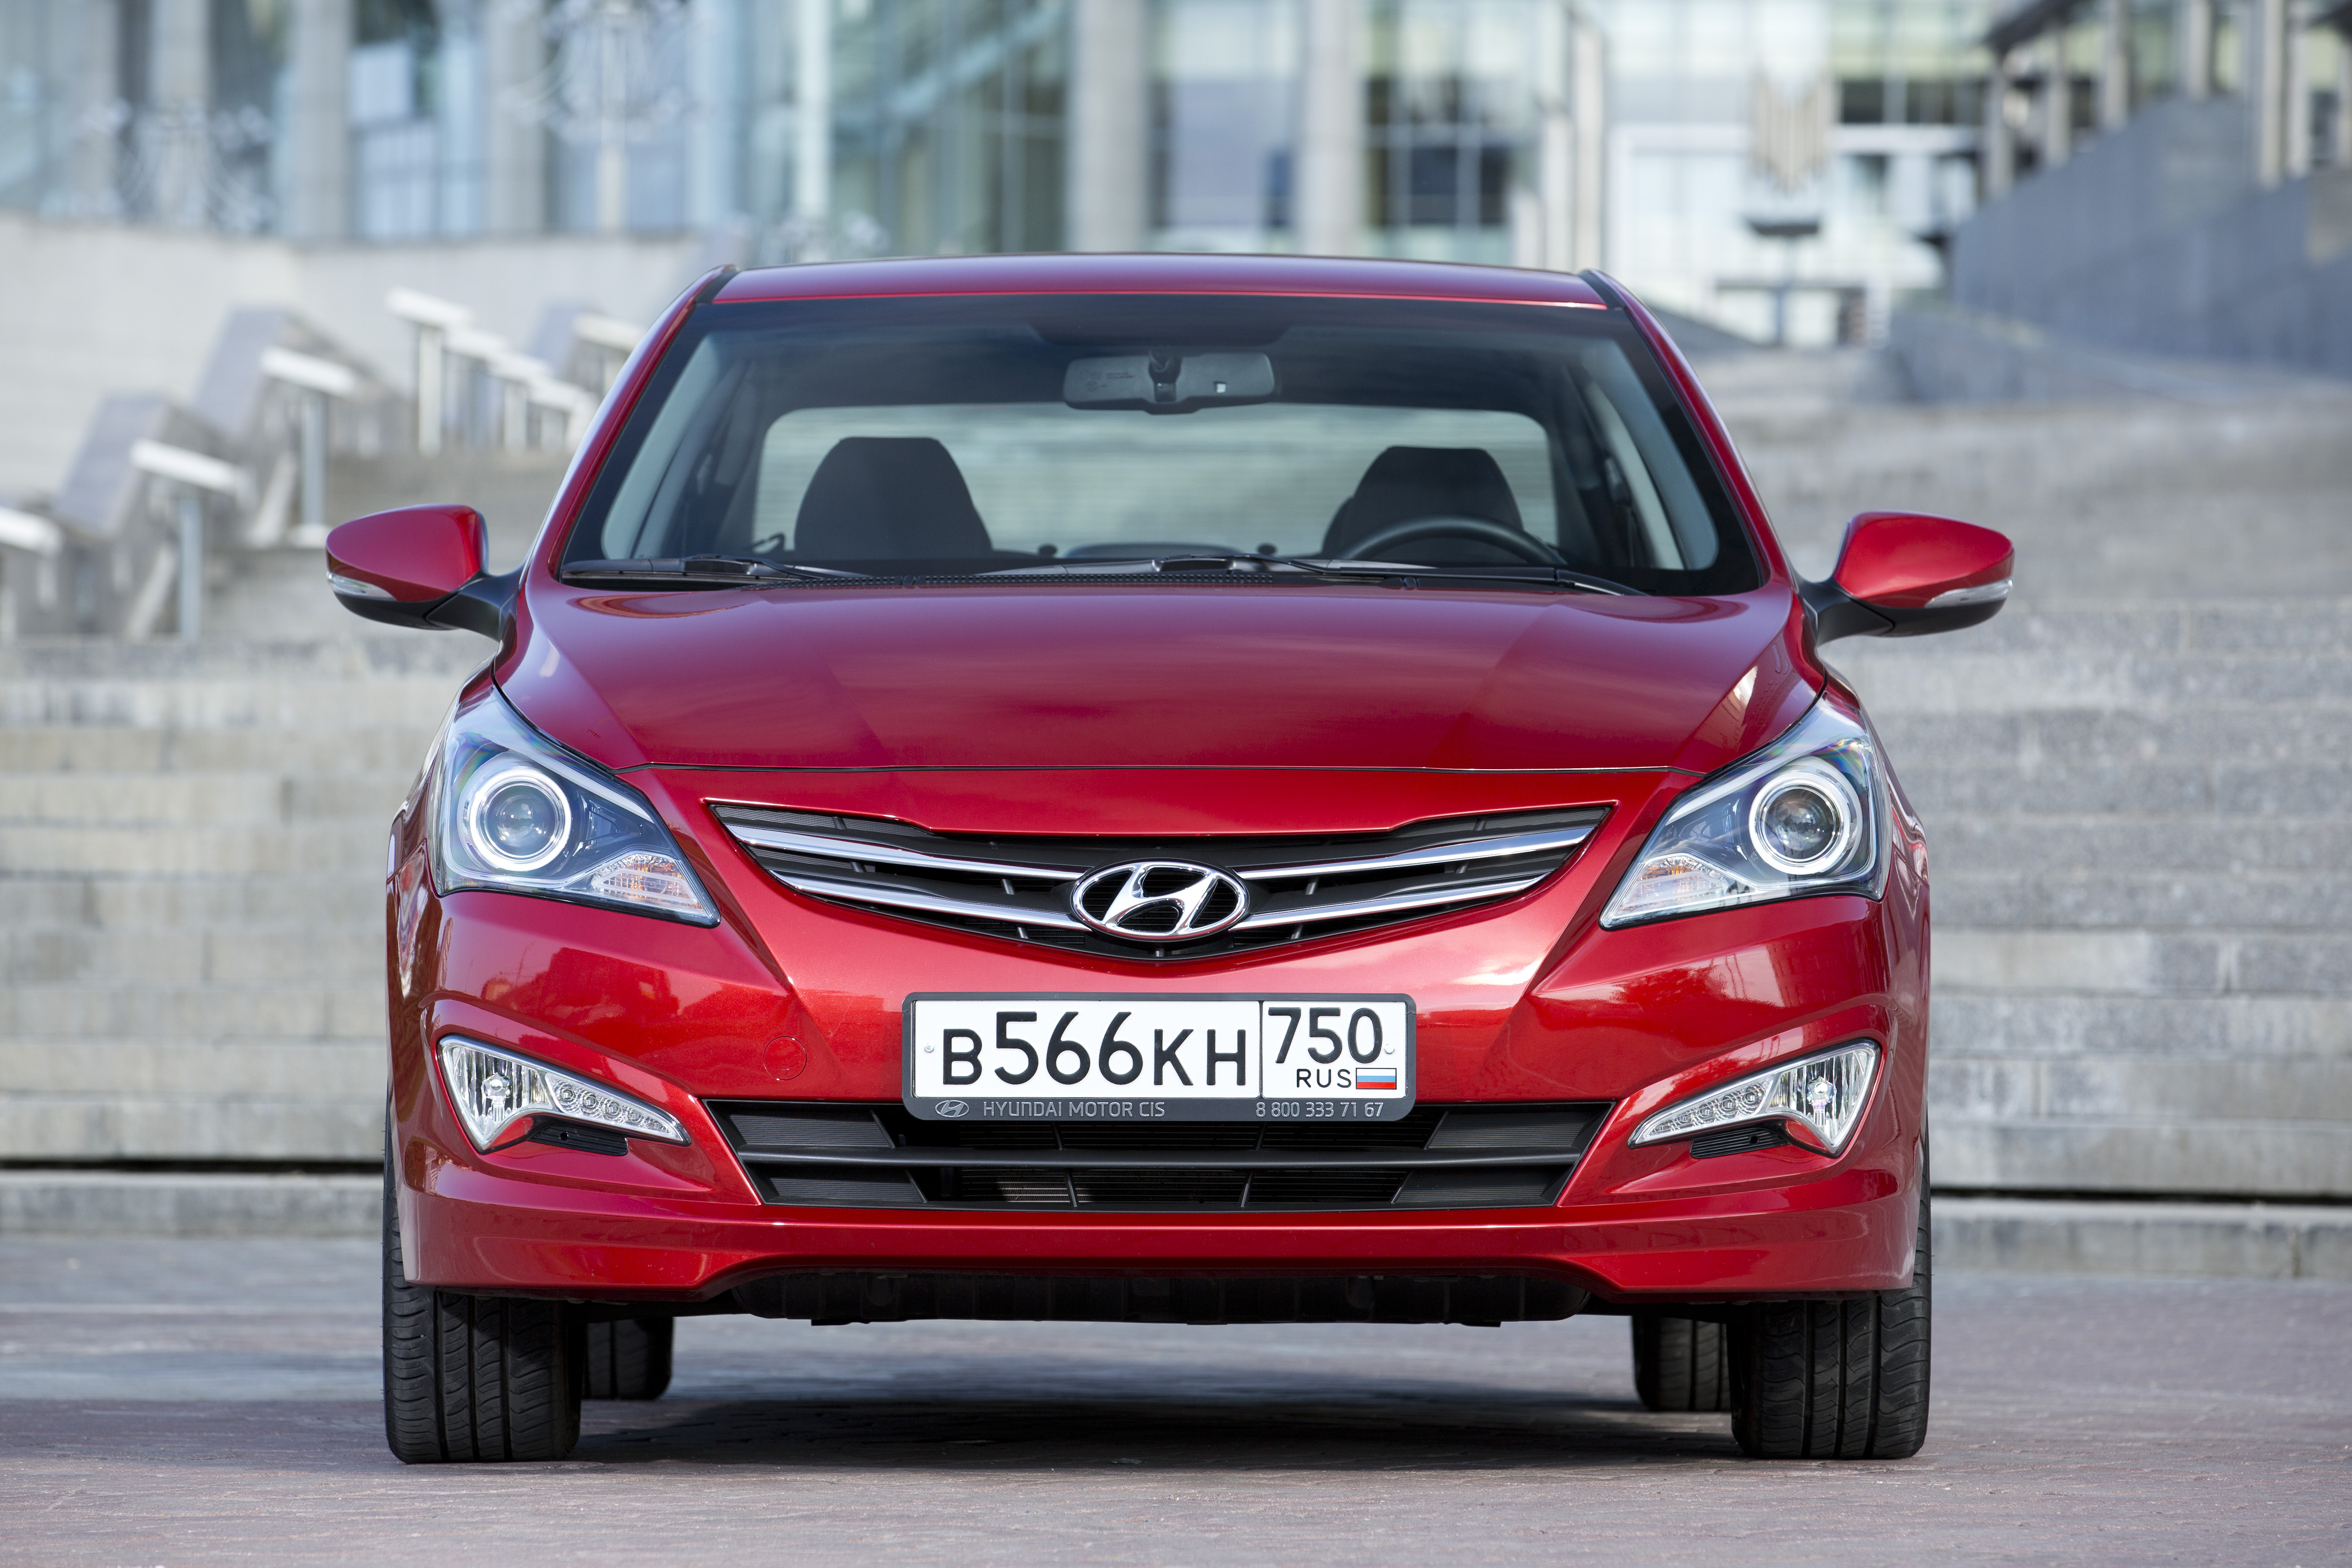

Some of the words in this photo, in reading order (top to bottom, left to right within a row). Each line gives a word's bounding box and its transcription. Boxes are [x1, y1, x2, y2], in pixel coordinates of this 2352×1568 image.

[1267, 1007, 1383, 1064] 750
[1297, 1068, 1352, 1088] RUS
[983, 1102, 1061, 1117] HYUNDAI
[1068, 1102, 1133, 1117] MOTOR
[1139, 1102, 1165, 1117] CIS
[1256, 1102, 1266, 1118] 8
[1271, 1102, 1300, 1117] 800
[1305, 1102, 1334, 1117] 333
[1340, 1102, 1357, 1117] 71
[1364, 1102, 1384, 1117] 67
